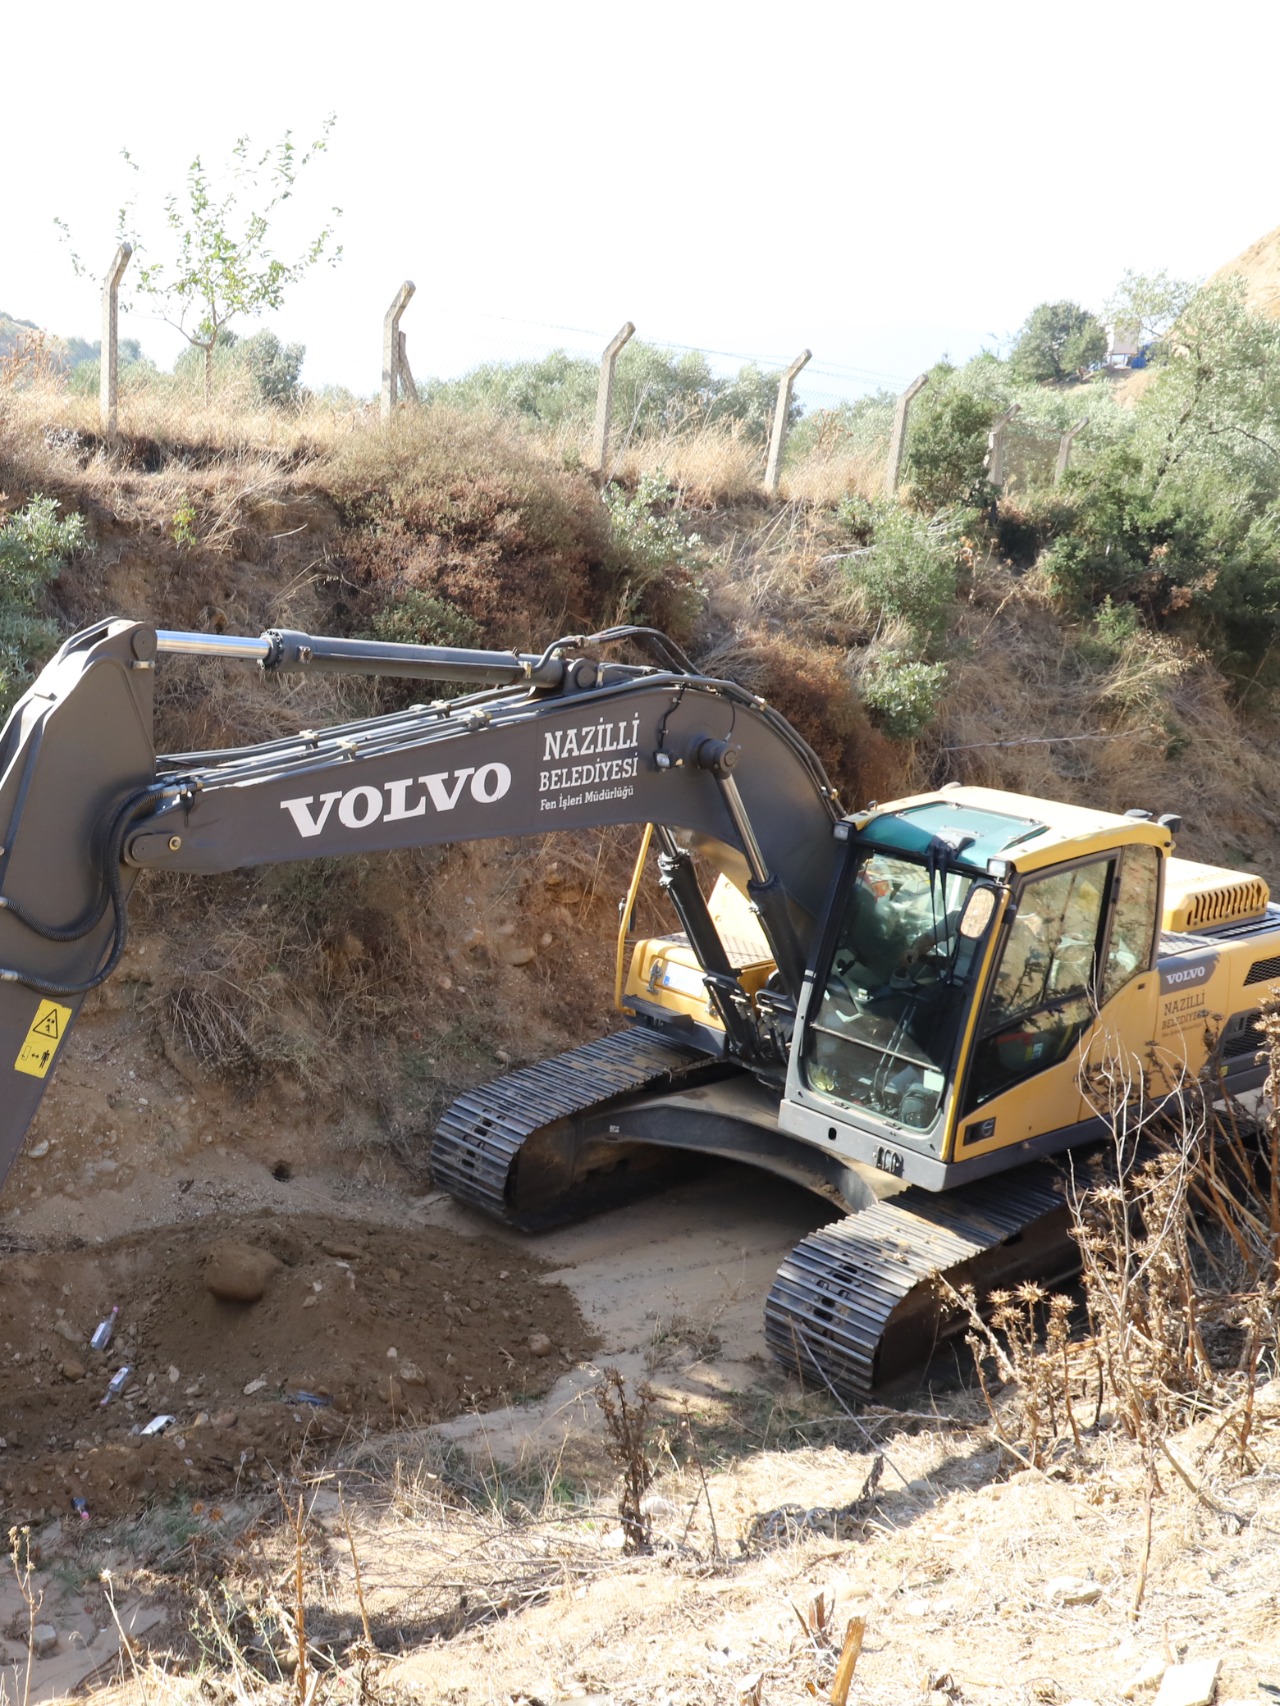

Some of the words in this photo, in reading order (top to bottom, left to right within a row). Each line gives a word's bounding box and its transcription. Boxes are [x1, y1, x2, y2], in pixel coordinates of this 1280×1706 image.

[542, 712, 640, 761] NAZİLLİ
[538, 752, 639, 792] BELEDİYESİ
[280, 762, 512, 839] VOLVO
[540, 799, 557, 811] Fen
[558, 793, 583, 810] İşleri
[584, 785, 634, 804] Müdürlüğü
[1166, 966, 1205, 984] VOLVO
[1164, 989, 1205, 1016] NAZİLLİ
